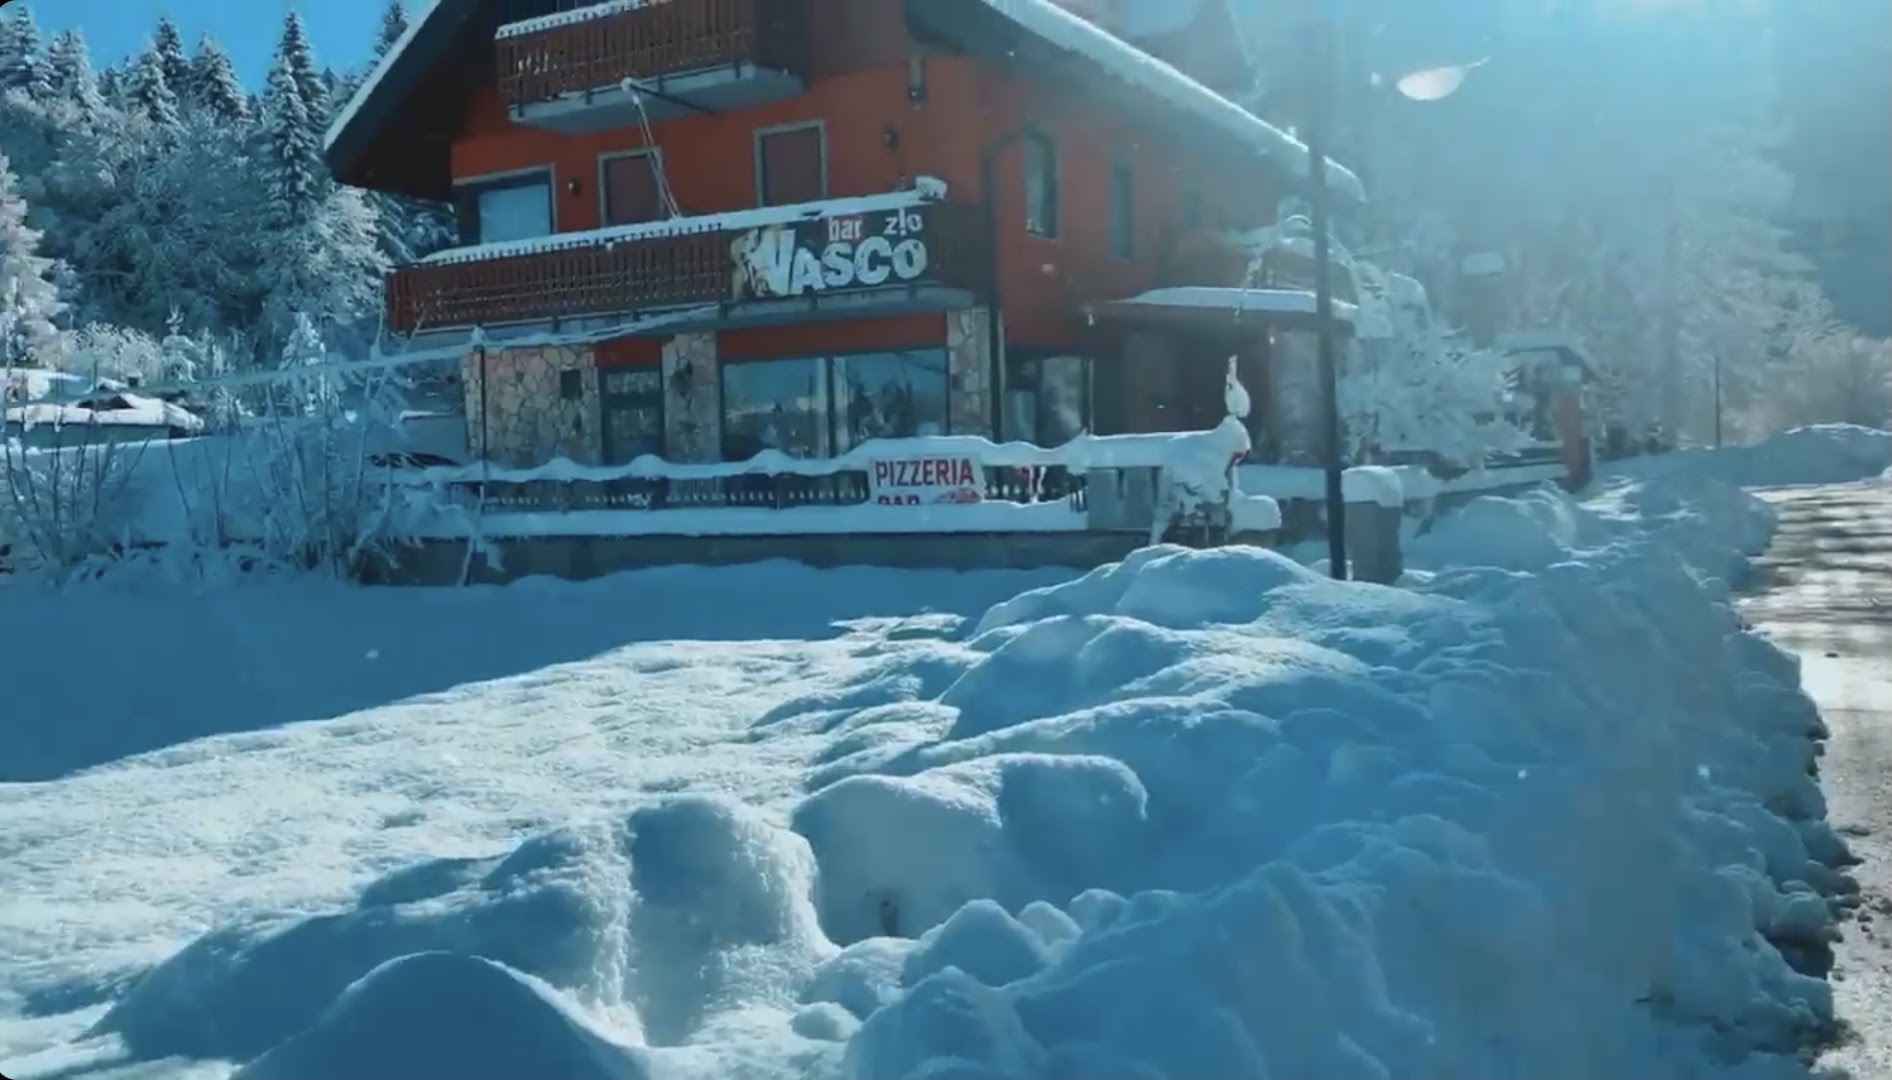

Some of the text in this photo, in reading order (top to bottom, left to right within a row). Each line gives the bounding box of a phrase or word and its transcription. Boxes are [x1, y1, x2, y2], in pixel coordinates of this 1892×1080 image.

[828, 215, 864, 242] bar
[751, 229, 928, 297] VASCO
[875, 458, 975, 487] PIZZERIA
